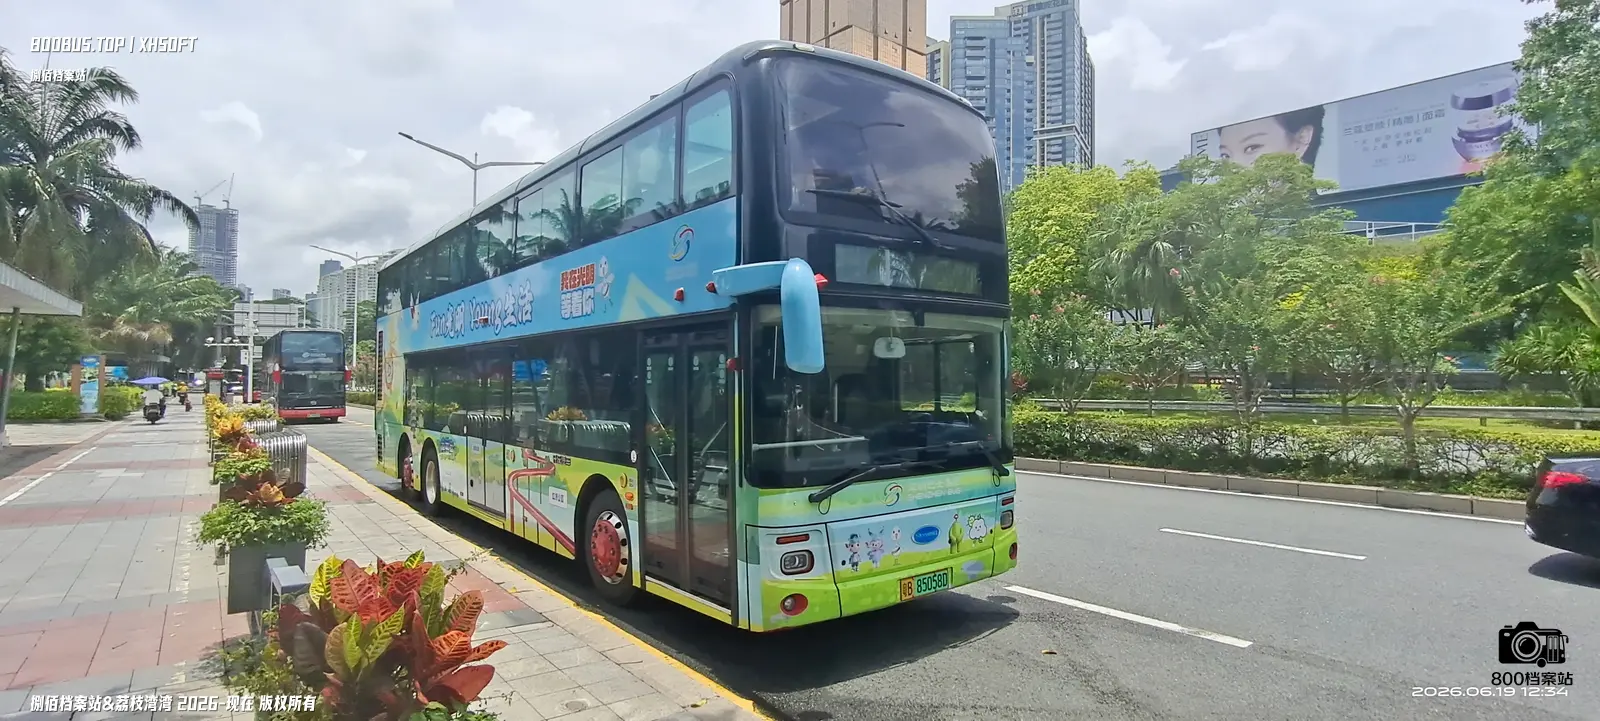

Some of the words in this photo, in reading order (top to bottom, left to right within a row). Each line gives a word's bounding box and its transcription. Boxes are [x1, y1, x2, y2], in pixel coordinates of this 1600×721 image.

[561, 263, 595, 291] 我在光明
[560, 286, 595, 320] 等着你
[916, 572, 948, 594] 85058D
